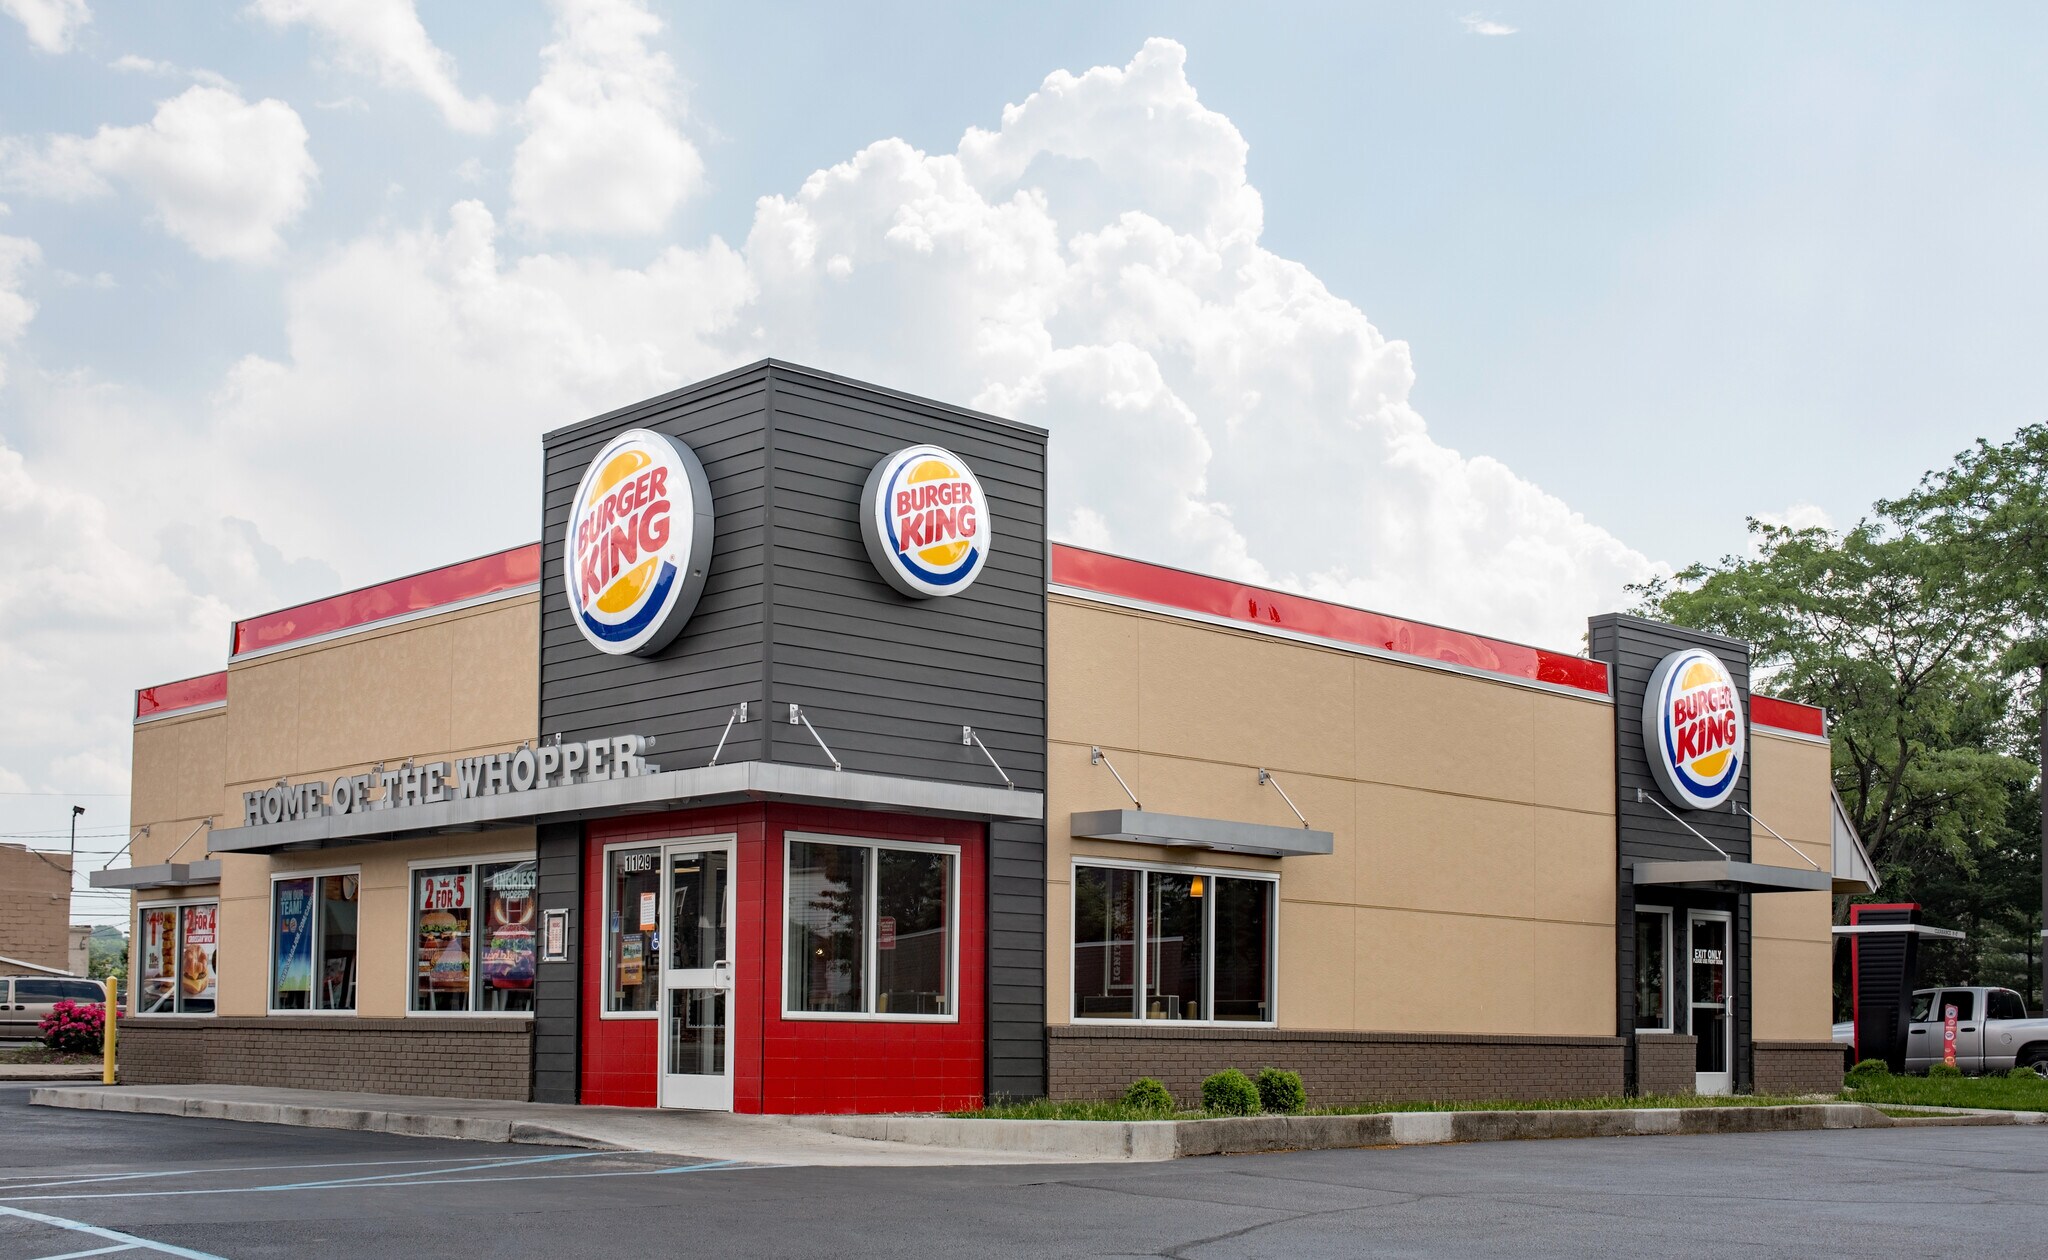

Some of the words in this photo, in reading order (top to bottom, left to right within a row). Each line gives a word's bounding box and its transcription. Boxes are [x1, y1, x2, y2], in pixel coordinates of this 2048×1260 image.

[578, 466, 668, 559] BURGER
[896, 482, 973, 518] BURGER
[899, 505, 976, 554] KING
[579, 500, 671, 611] KING
[1674, 686, 1733, 727] BURGER
[1676, 710, 1736, 765] KING
[243, 781, 328, 826] HOME
[332, 774, 376, 814] OF
[381, 761, 452, 808] THE
[455, 734, 646, 799] WHOPPER
[625, 854, 651, 871] 1129
[281, 890, 292, 901] JOIN
[425, 878, 434, 909] 2
[436, 889, 453, 909] FOR
[493, 871, 537, 890] ANGRIEST
[500, 890, 529, 899] WHOPPER
[187, 909, 194, 934] 2
[195, 914, 208, 930] FOR
[1694, 949, 1707, 958] EXIT
[1708, 950, 1722, 959] ONLY
